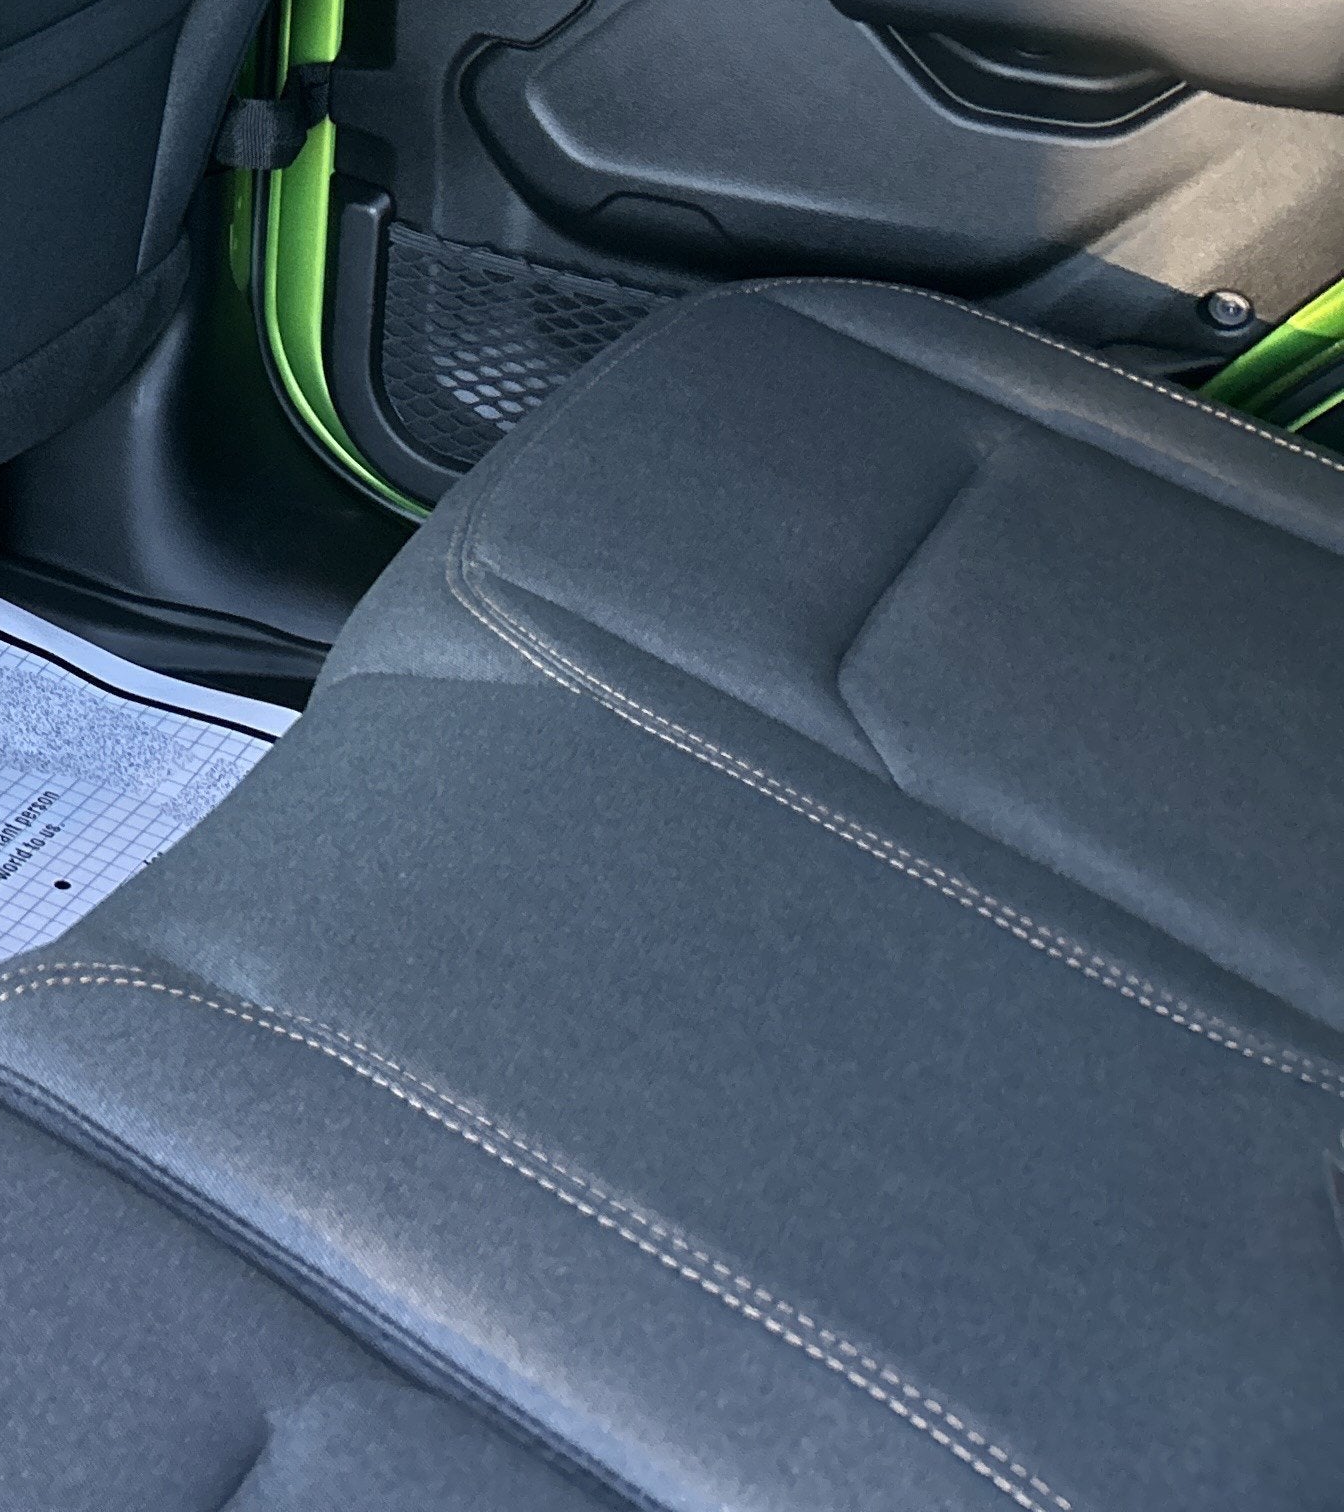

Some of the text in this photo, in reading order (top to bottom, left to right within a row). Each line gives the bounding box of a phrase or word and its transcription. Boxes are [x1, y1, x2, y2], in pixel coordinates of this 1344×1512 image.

[14, 791, 61, 828] person
[22, 837, 46, 850] to
[39, 822, 66, 838] us.
